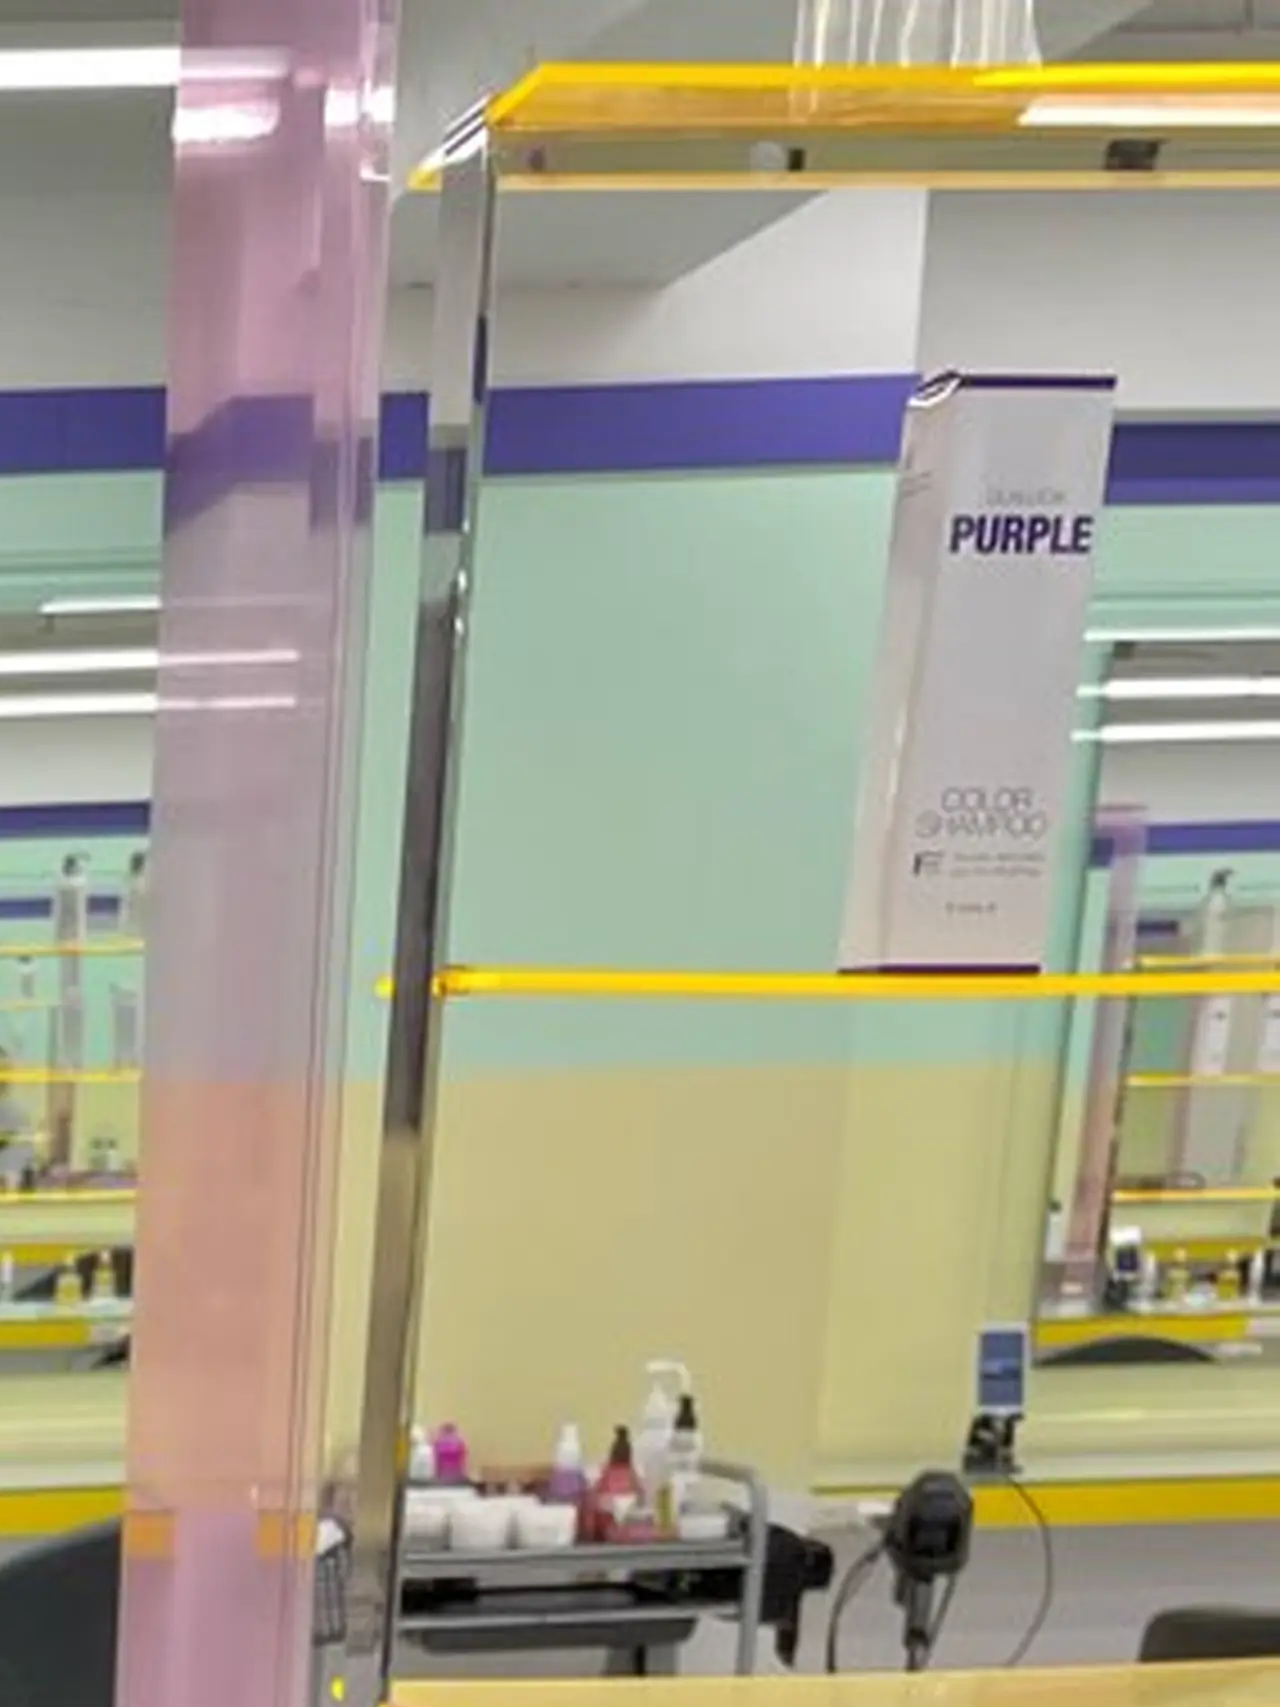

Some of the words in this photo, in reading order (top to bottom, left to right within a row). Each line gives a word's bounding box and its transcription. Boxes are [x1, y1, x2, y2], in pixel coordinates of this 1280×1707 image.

[949, 514, 1095, 554] PURPLE
[941, 786, 1032, 814] COLOR
[914, 809, 1047, 840] SHAMPOO
